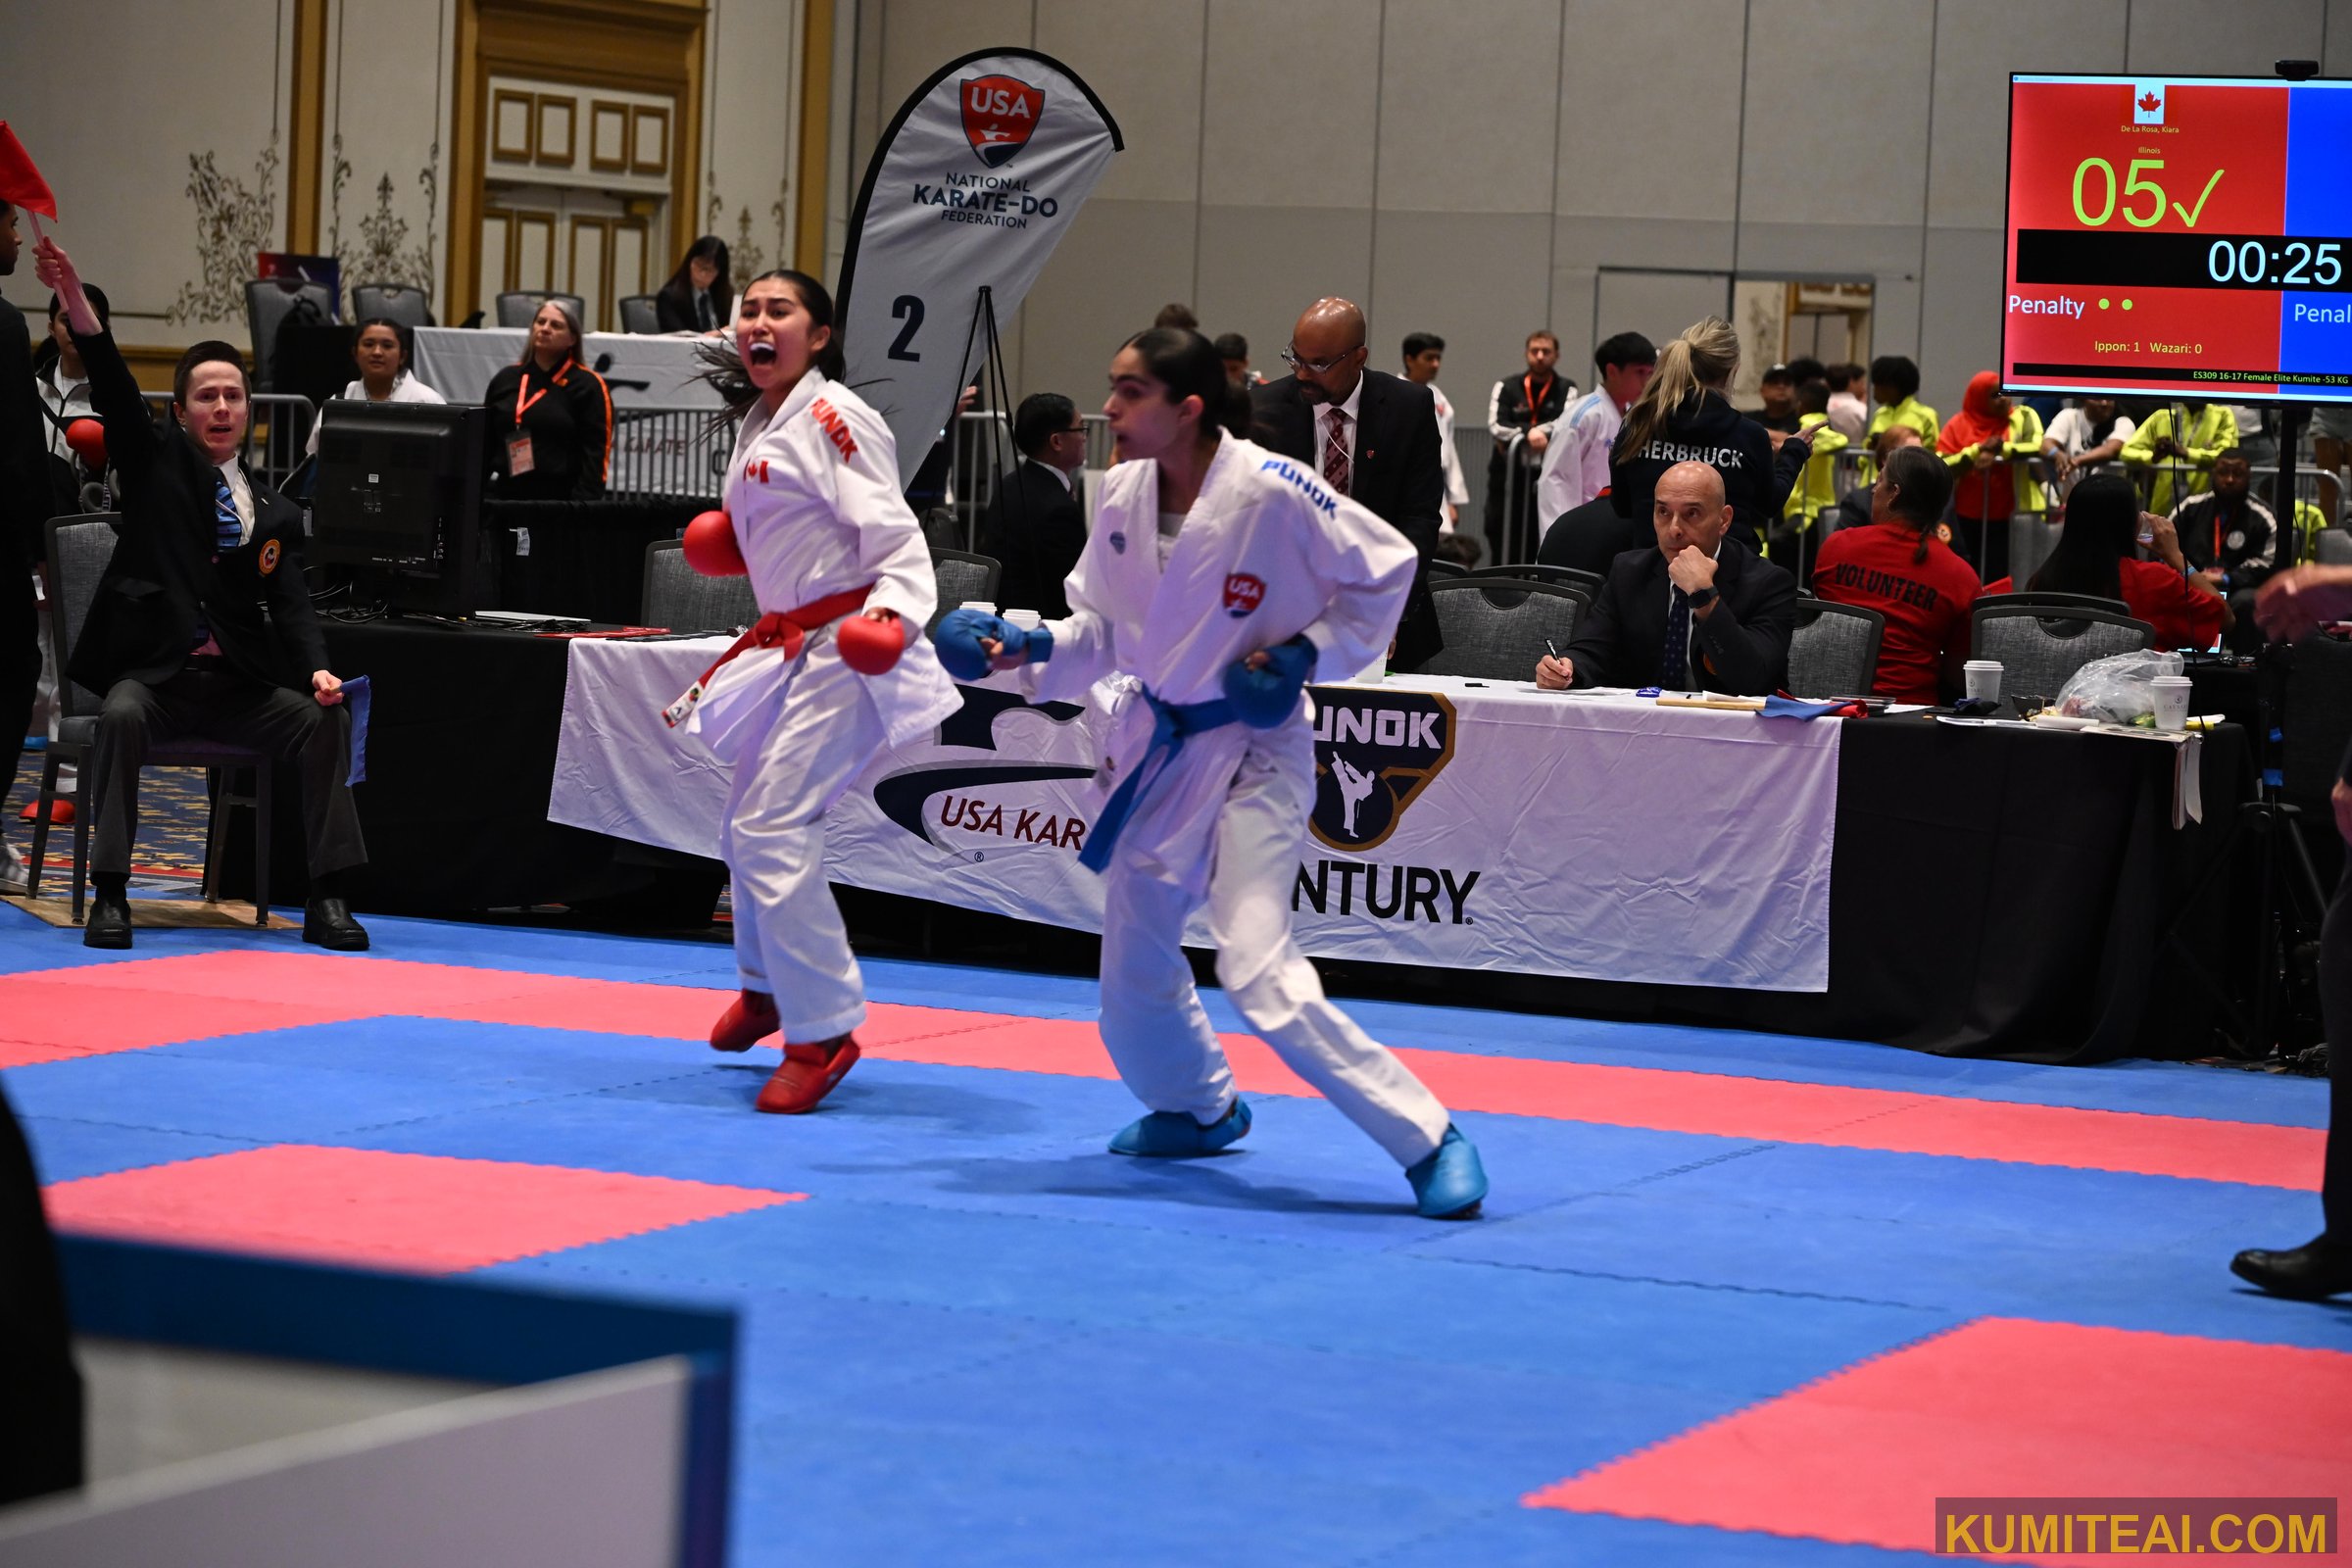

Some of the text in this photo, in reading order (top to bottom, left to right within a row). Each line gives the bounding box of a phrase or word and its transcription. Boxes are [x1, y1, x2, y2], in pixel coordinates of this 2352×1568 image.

[970, 87, 1030, 119] USA
[946, 172, 1031, 192] NATIONAL
[2073, 157, 2167, 228] 05
[913, 184, 1058, 219] KARATE-DO
[941, 210, 1027, 228] FEDERATION
[2208, 240, 2342, 285] 00:25
[2008, 295, 2085, 318] Penalty
[2294, 304, 2352, 323] Penal
[887, 294, 925, 363] 2
[2094, 340, 2140, 353] Ippon: 1
[2149, 342, 2202, 354] Wazari: 0
[2193, 370, 2217, 379] ES309
[2219, 371, 2241, 380] 16-17
[2274, 373, 2290, 382] Elite
[2292, 374, 2321, 383] Kumite
[2322, 375, 2335, 384] -53
[810, 396, 858, 465] UNOK
[1229, 577, 1260, 600] USA
[1835, 563, 1938, 612] VOLUNTEER
[940, 795, 1086, 851] USA KAR
